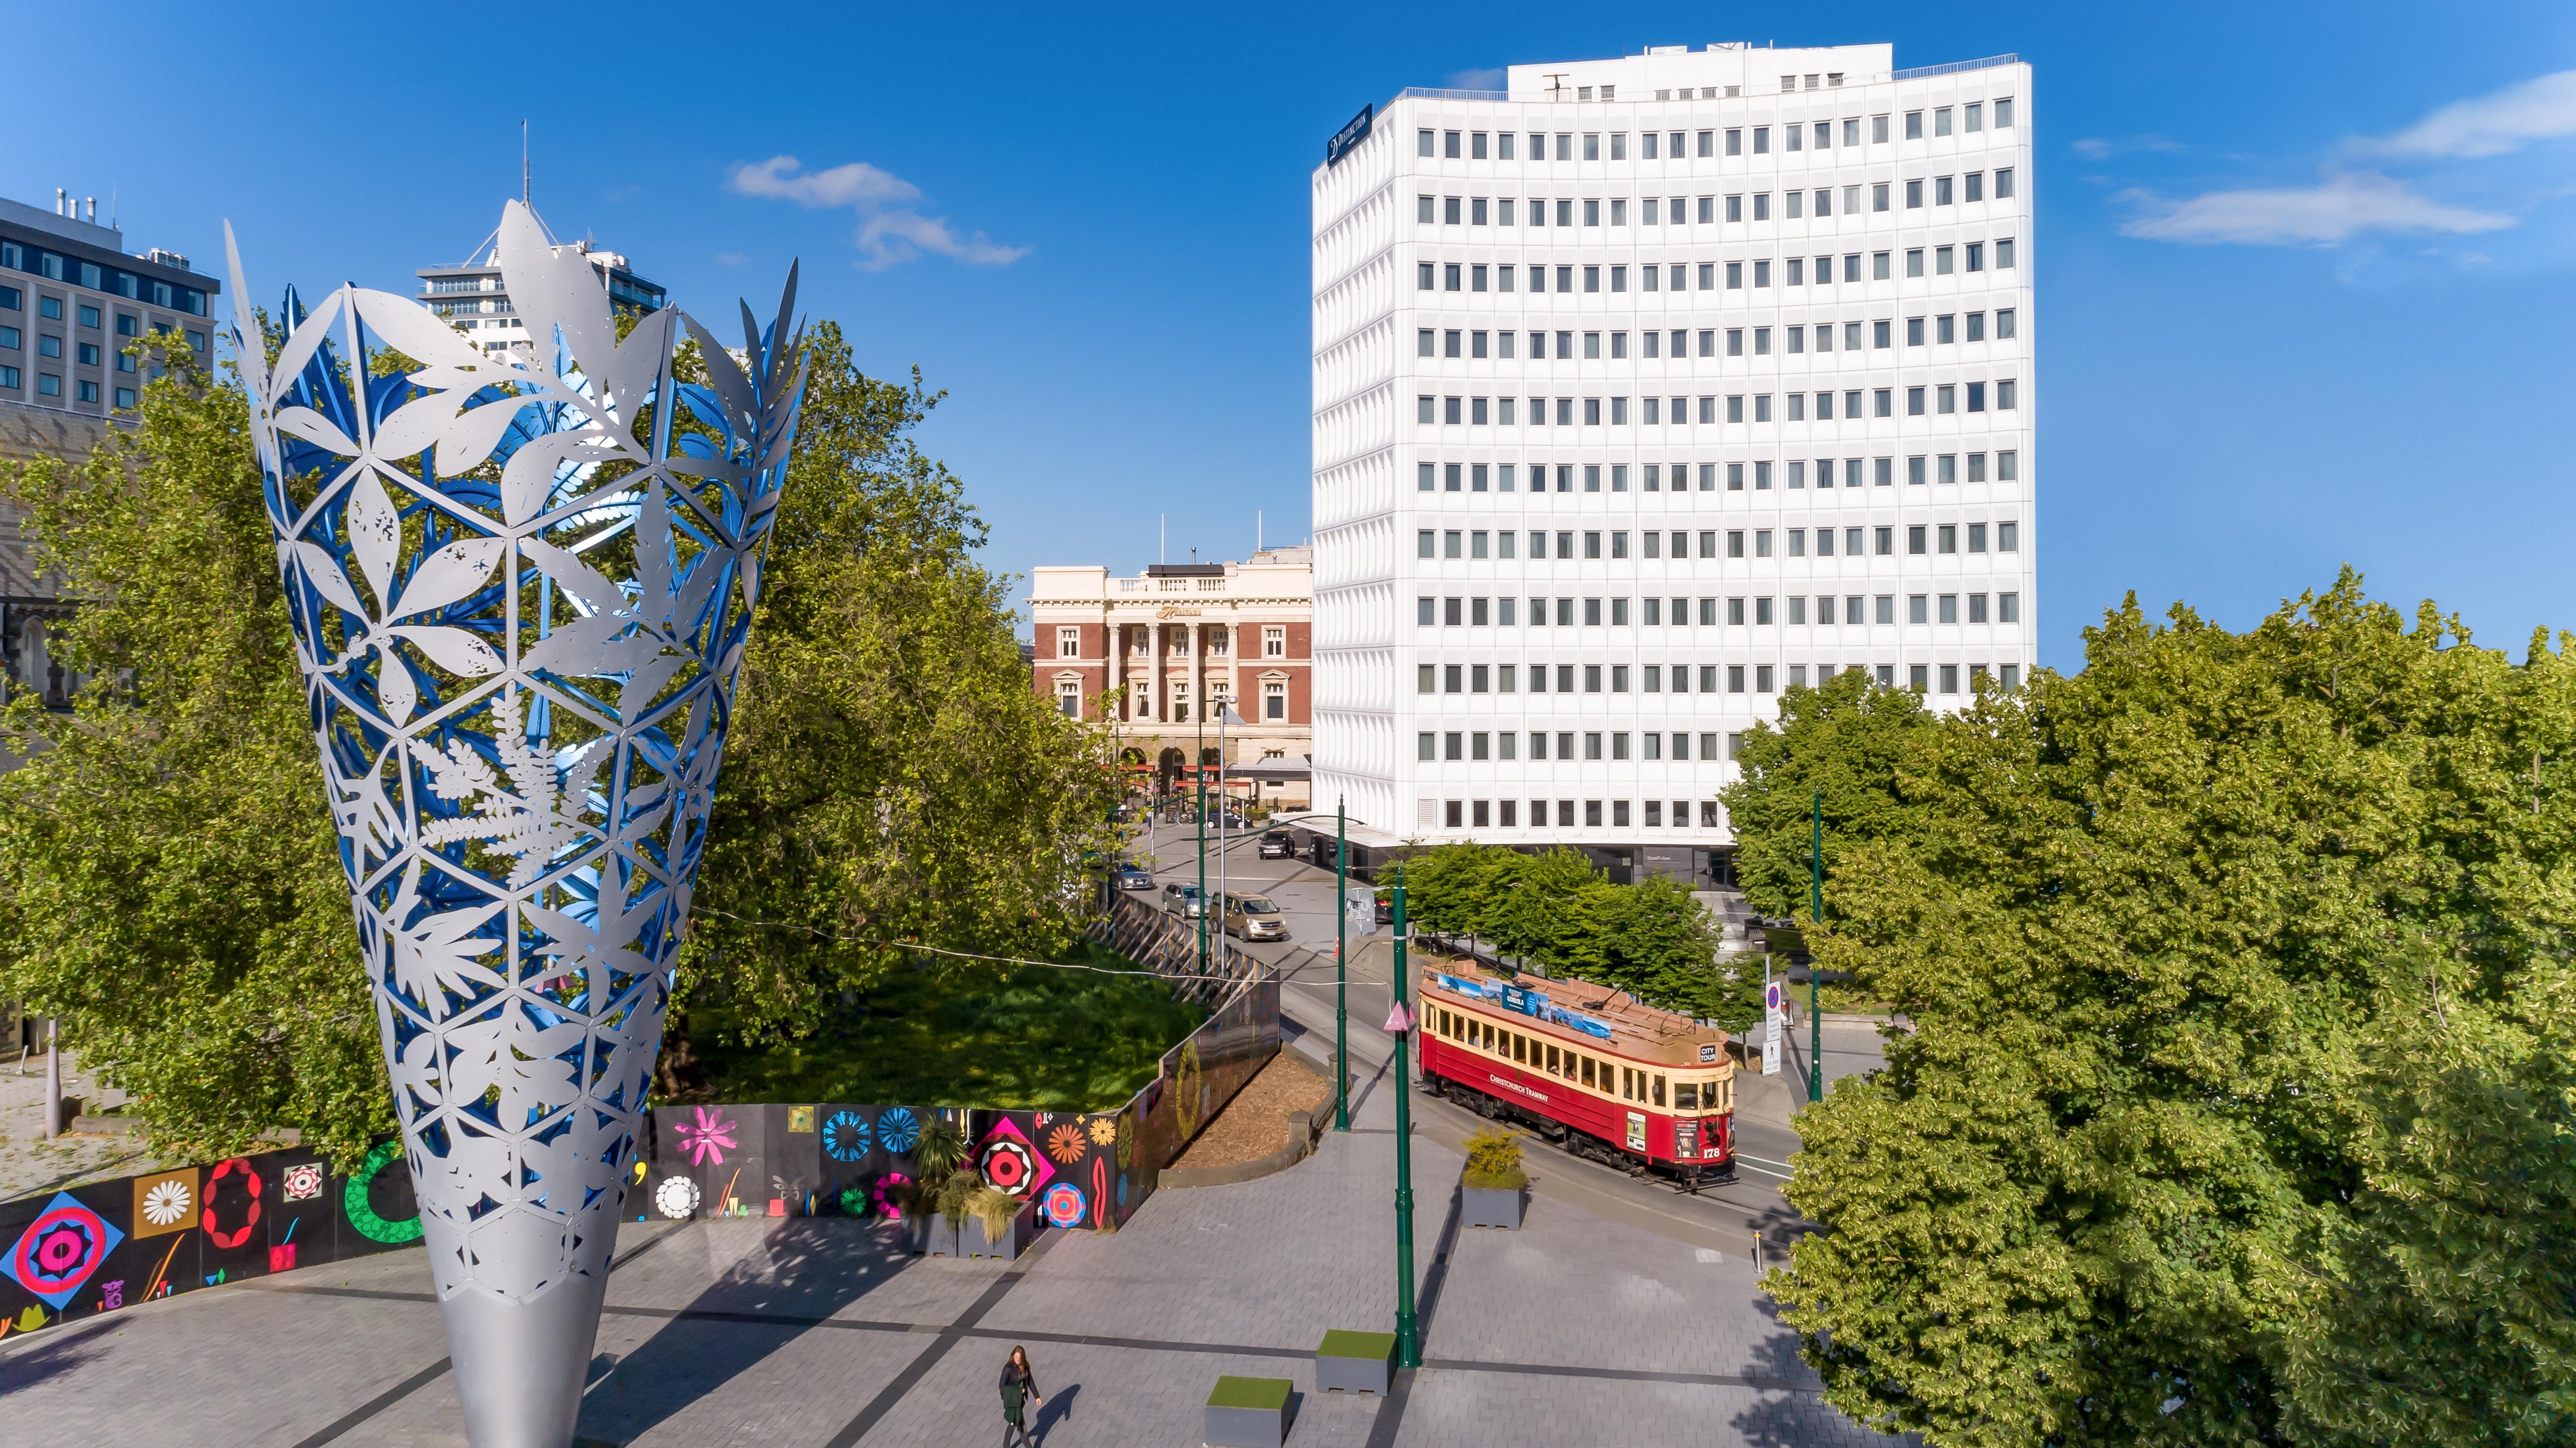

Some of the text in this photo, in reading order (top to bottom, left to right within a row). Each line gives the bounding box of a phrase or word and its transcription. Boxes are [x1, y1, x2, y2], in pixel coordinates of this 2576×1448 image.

[1338, 113, 1366, 147] DISTINCTION
[1490, 1074, 1549, 1102] CHRISTCHURCH TRAMWAY
[1703, 1147, 1720, 1158] 178
